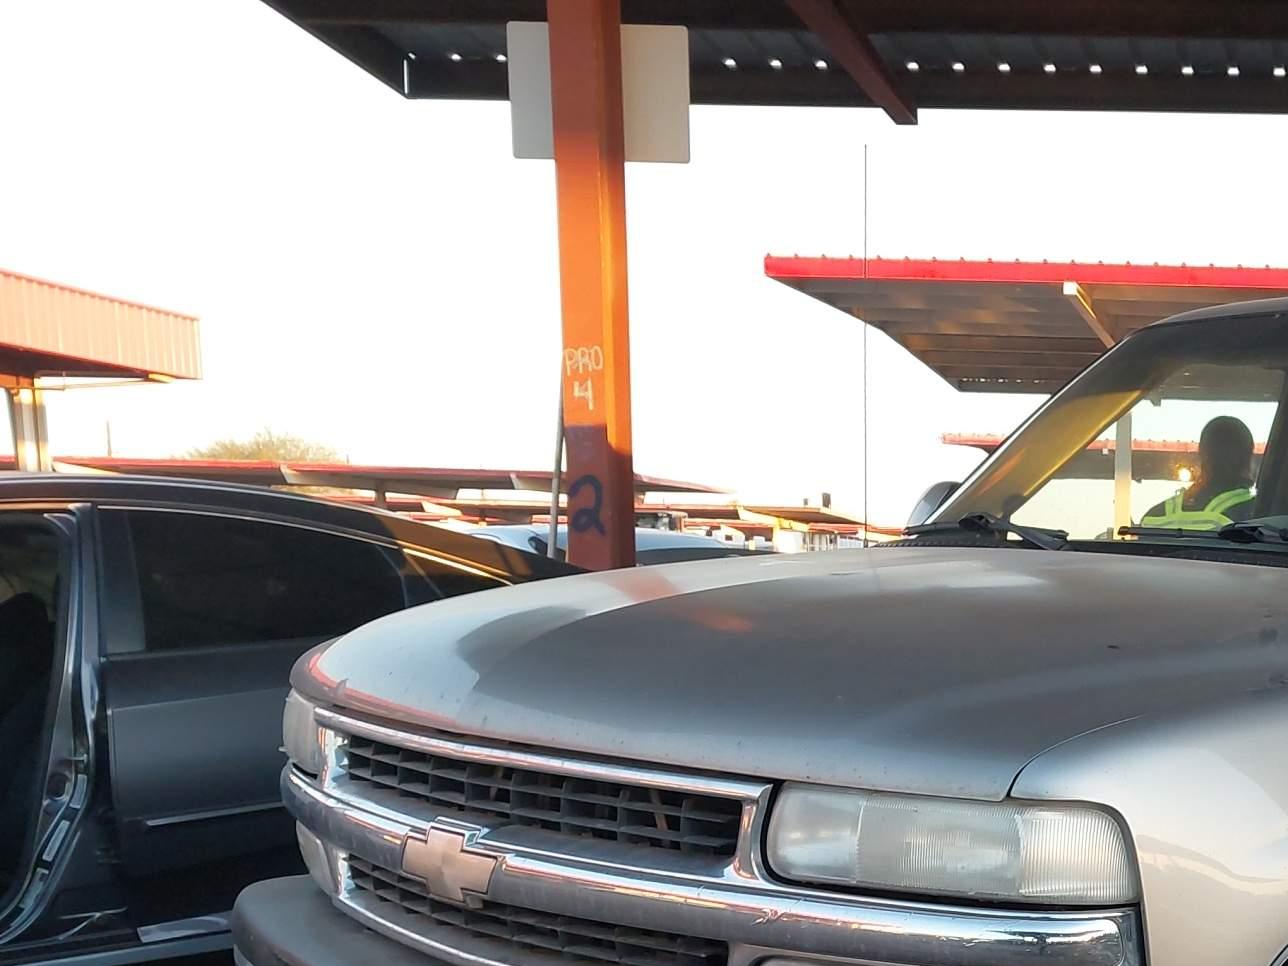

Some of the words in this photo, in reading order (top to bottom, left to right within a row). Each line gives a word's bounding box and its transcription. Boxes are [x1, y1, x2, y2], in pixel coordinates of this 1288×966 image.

[564, 345, 604, 376] PRO
[573, 379, 594, 411] 4
[569, 474, 606, 536] 2
